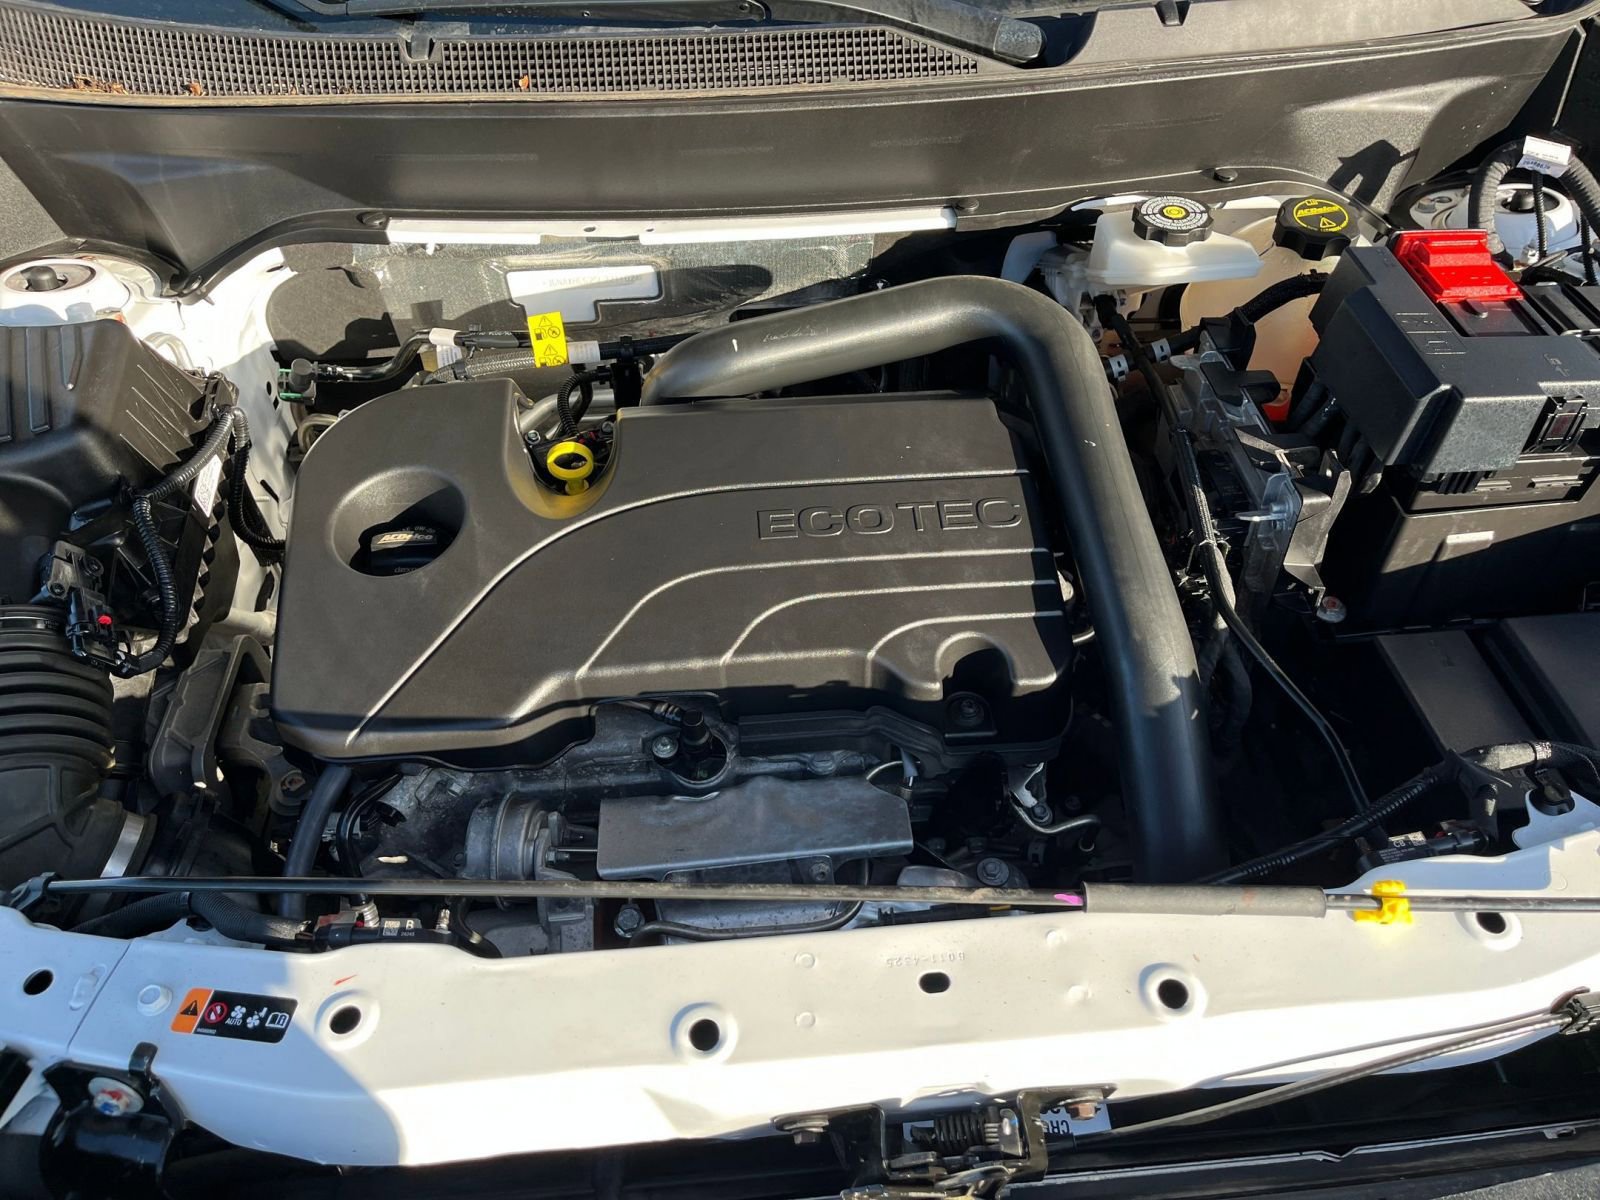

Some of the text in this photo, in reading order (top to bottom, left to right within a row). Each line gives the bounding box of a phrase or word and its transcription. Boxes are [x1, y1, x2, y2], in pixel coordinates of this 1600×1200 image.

[757, 497, 1023, 540] ECOTEC
[377, 533, 433, 544] ACDelco
[405, 919, 415, 930] B
[225, 1017, 243, 1026] AUTO
